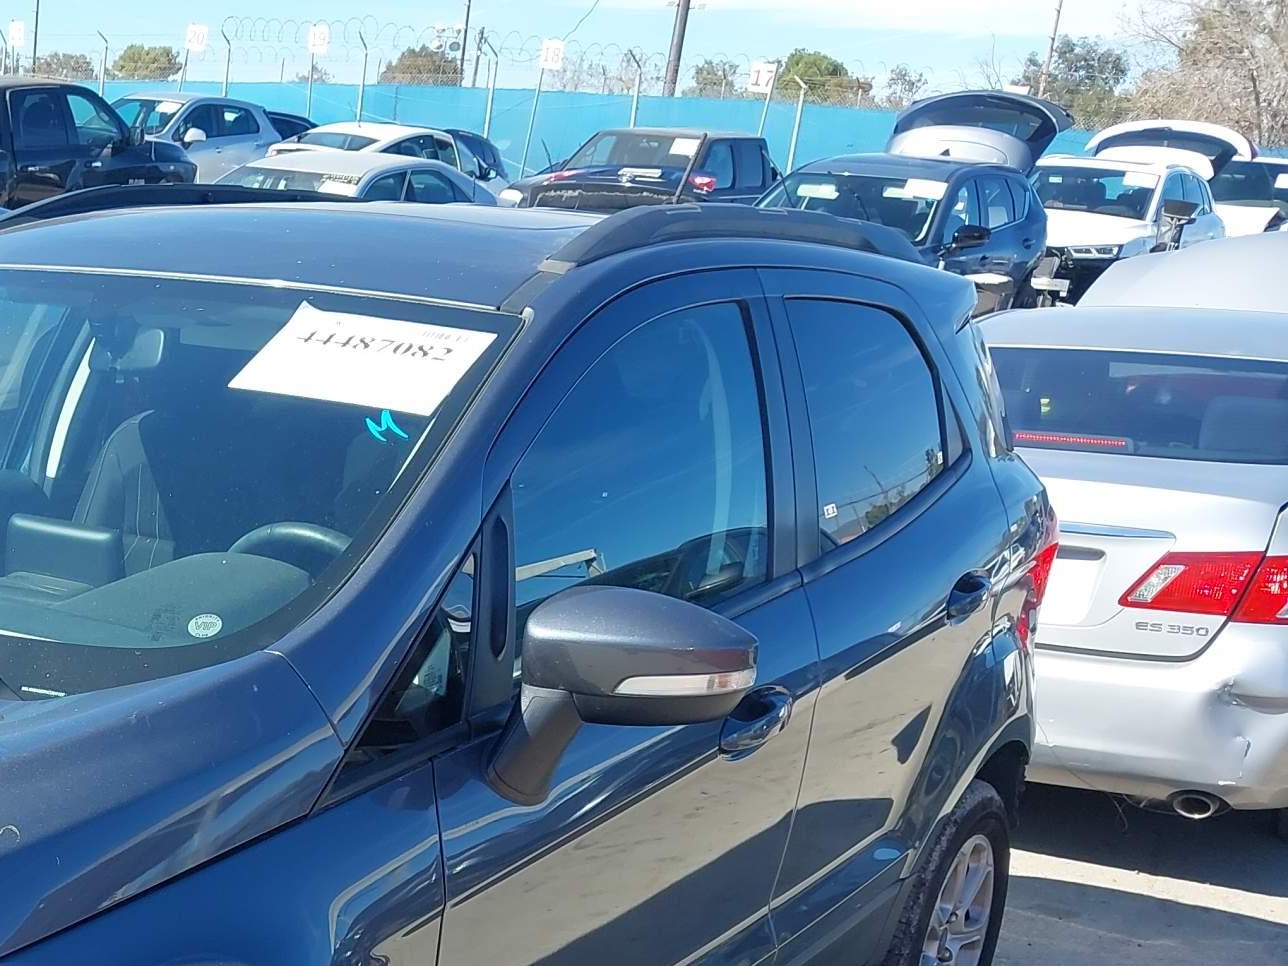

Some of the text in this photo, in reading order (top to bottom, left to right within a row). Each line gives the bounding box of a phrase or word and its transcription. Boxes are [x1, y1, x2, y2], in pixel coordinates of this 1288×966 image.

[188, 30, 205, 46] 20
[311, 32, 327, 47] 19
[750, 70, 774, 87] 17
[296, 329, 454, 363] 44487082
[1135, 621, 1210, 637] ES 350
